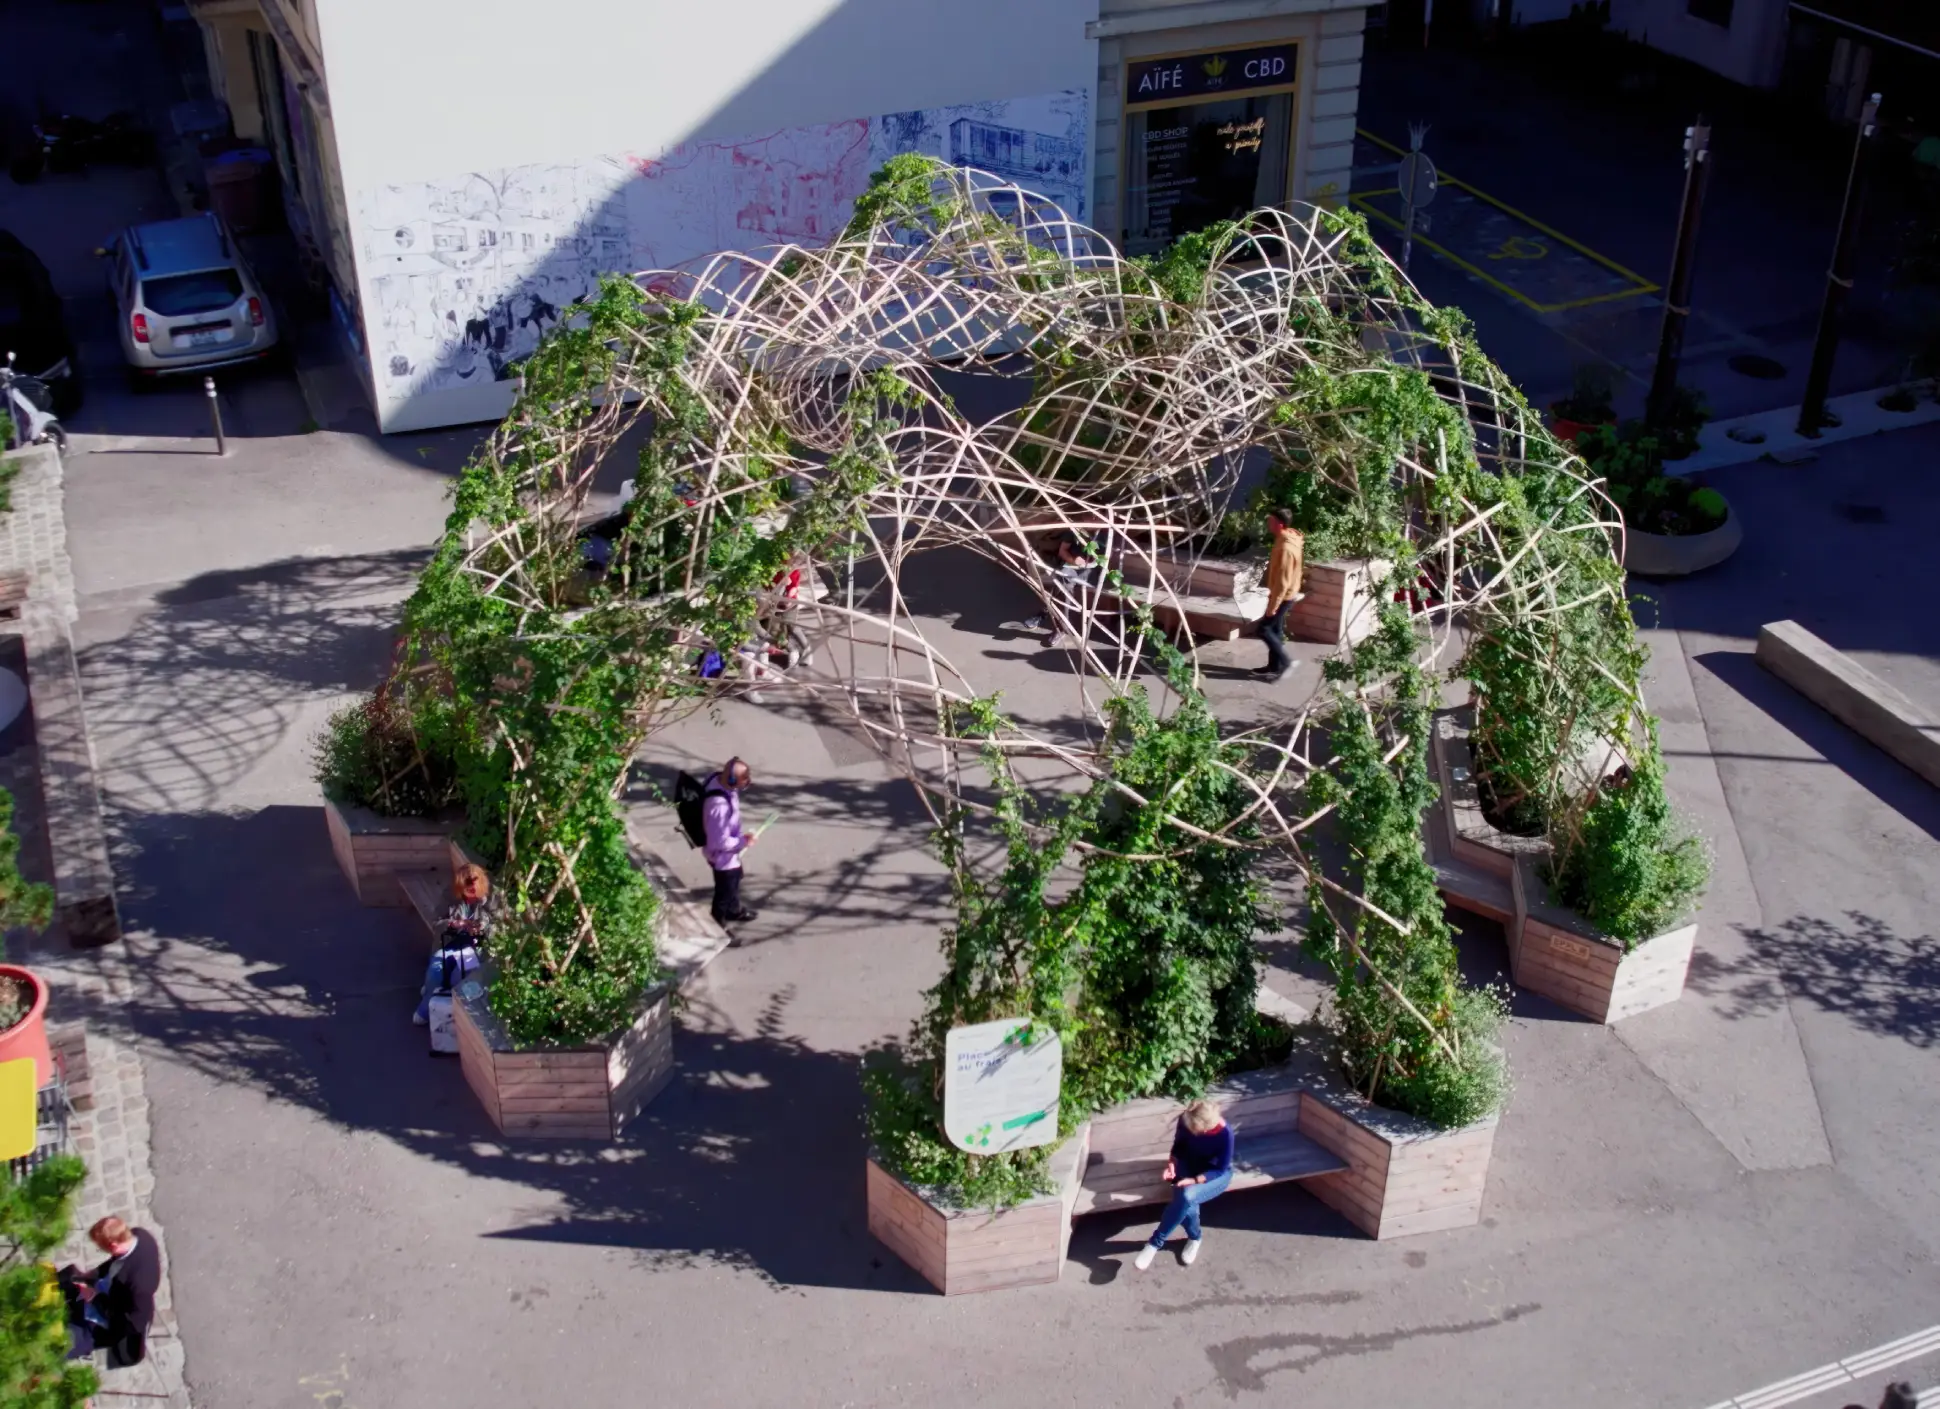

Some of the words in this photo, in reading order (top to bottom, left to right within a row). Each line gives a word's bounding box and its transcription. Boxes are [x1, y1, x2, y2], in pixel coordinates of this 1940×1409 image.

[1138, 63, 1183, 93] AÏFÉ
[1244, 57, 1286, 79] CBD
[1141, 130, 1162, 141] CBD
[1162, 126, 1189, 138] SHOP
